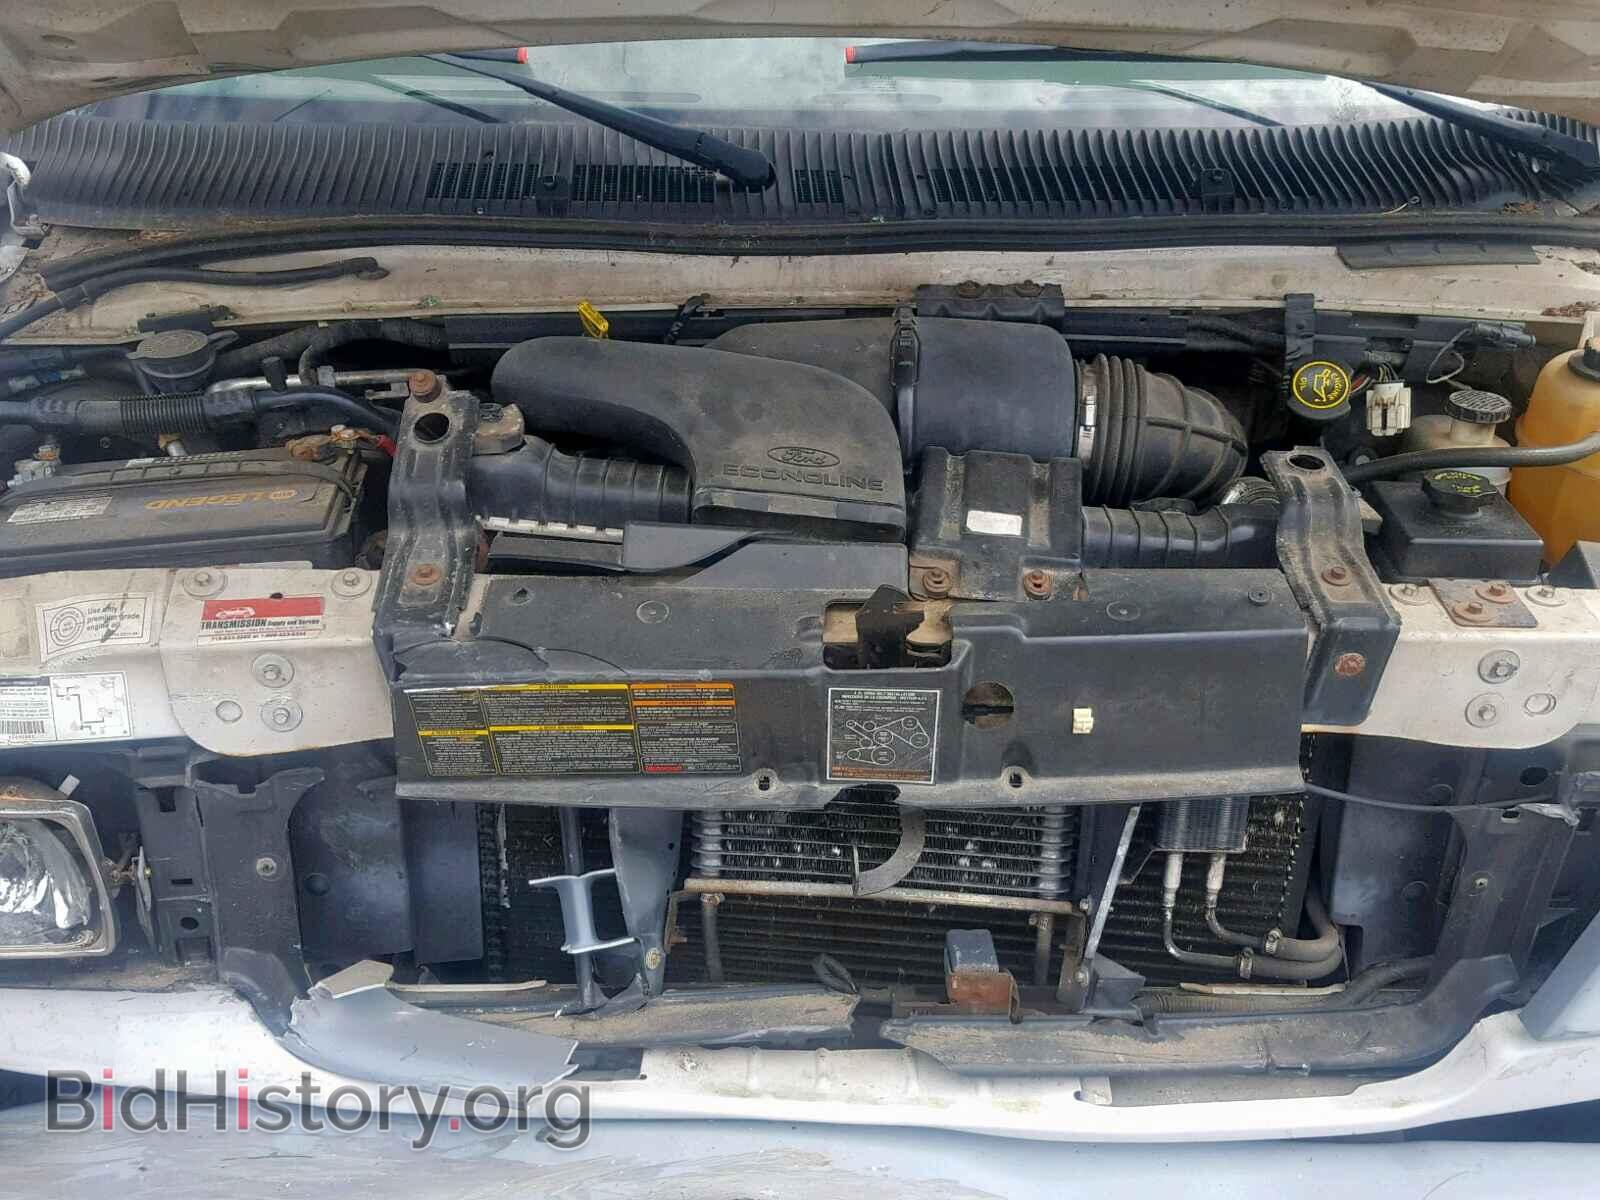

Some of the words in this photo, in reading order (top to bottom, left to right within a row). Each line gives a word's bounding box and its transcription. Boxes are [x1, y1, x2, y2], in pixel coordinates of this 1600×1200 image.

[1299, 377, 1308, 392] OIL
[1327, 372, 1342, 401] ENGINE
[723, 464, 884, 492] ECONOLINE
[144, 491, 269, 511] LEGEND
[200, 618, 267, 630] TRANSMISSION
